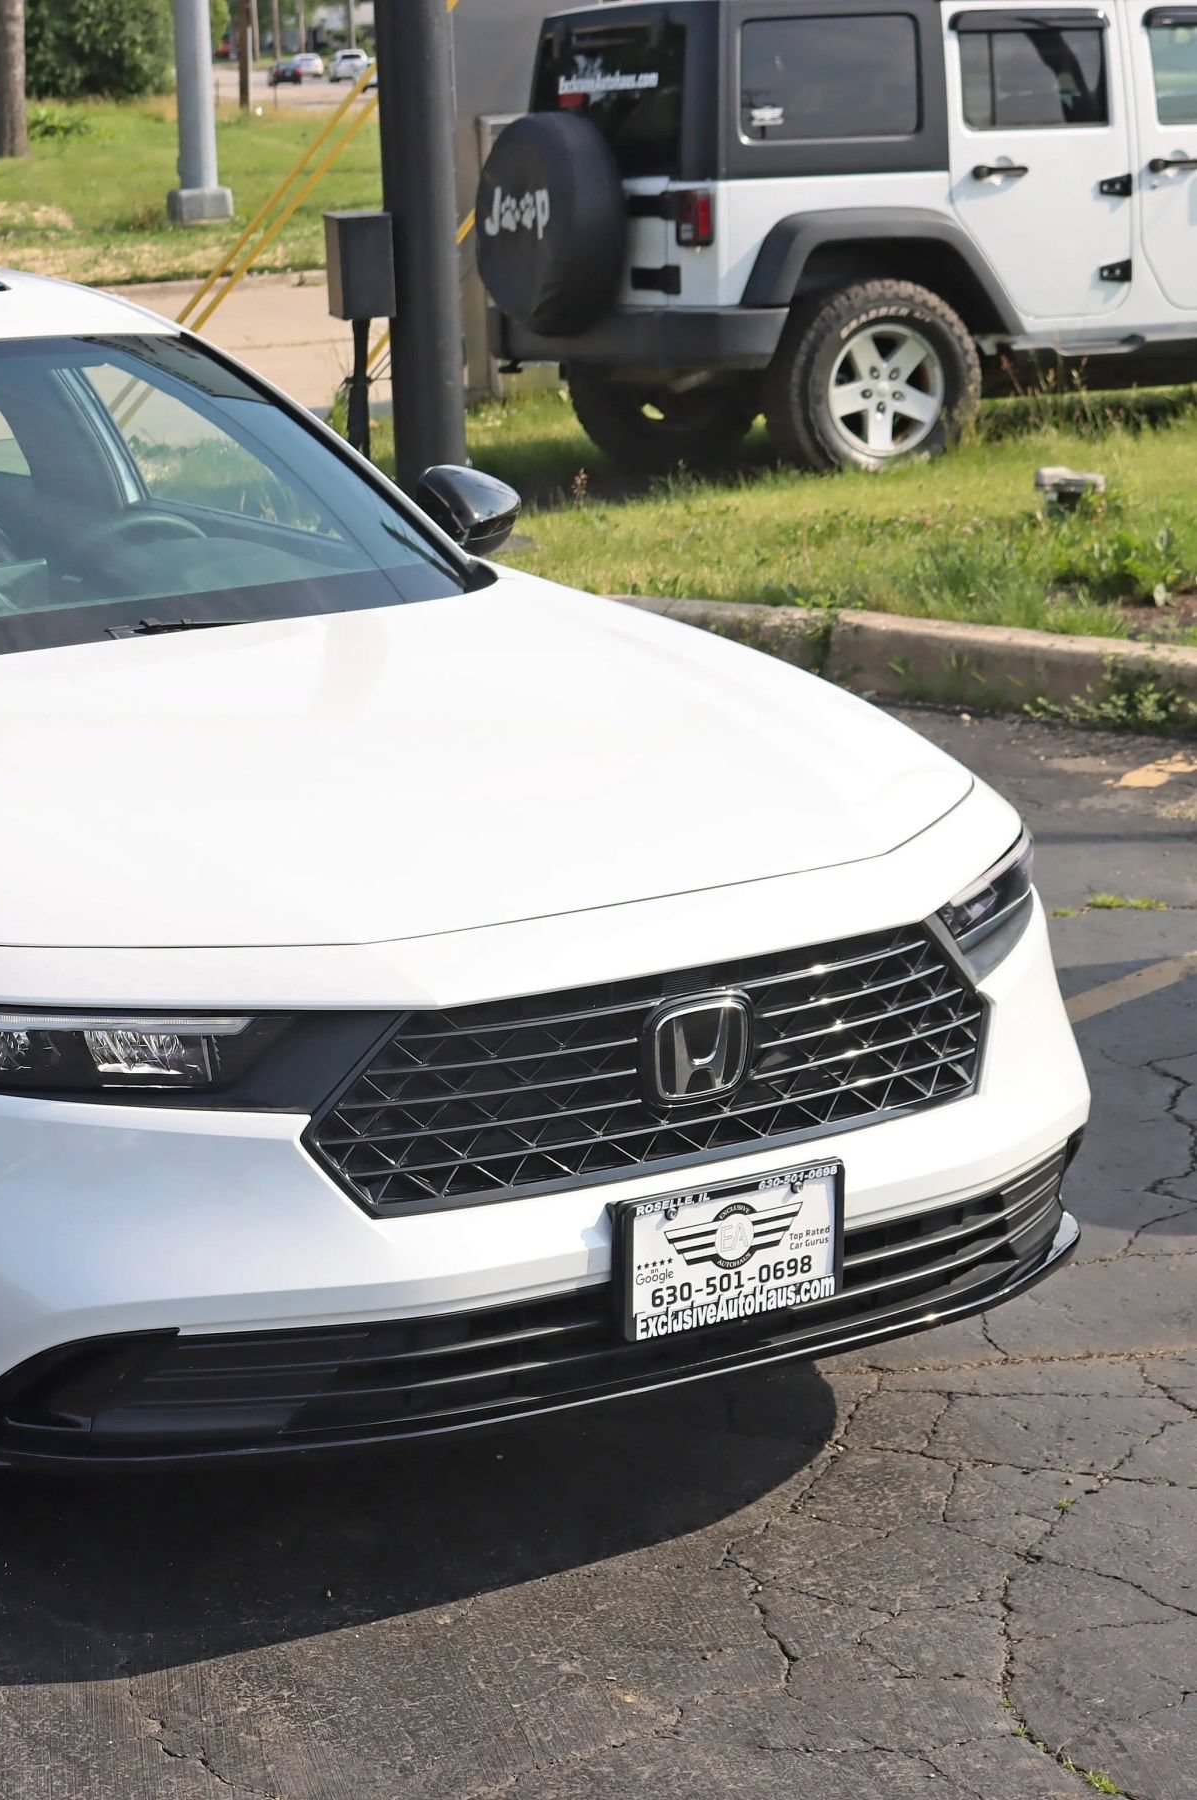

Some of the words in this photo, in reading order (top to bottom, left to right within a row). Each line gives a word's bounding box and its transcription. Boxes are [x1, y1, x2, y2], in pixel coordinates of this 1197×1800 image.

[758, 1165, 838, 1191] 630-501-0698
[698, 1192, 711, 1203] IL
[718, 1203, 751, 1220] EXCLUSIVE
[789, 1232, 804, 1241] Top
[805, 1225, 831, 1237] Rated
[789, 1242, 803, 1251] Car
[805, 1236, 829, 1247] Gurus
[717, 1251, 752, 1268] AUTOHAUS
[635, 1268, 674, 1286] Google
[651, 1254, 812, 1308] 630-501-0698
[636, 1275, 836, 1341] ExclusiveAutoHaus.com
